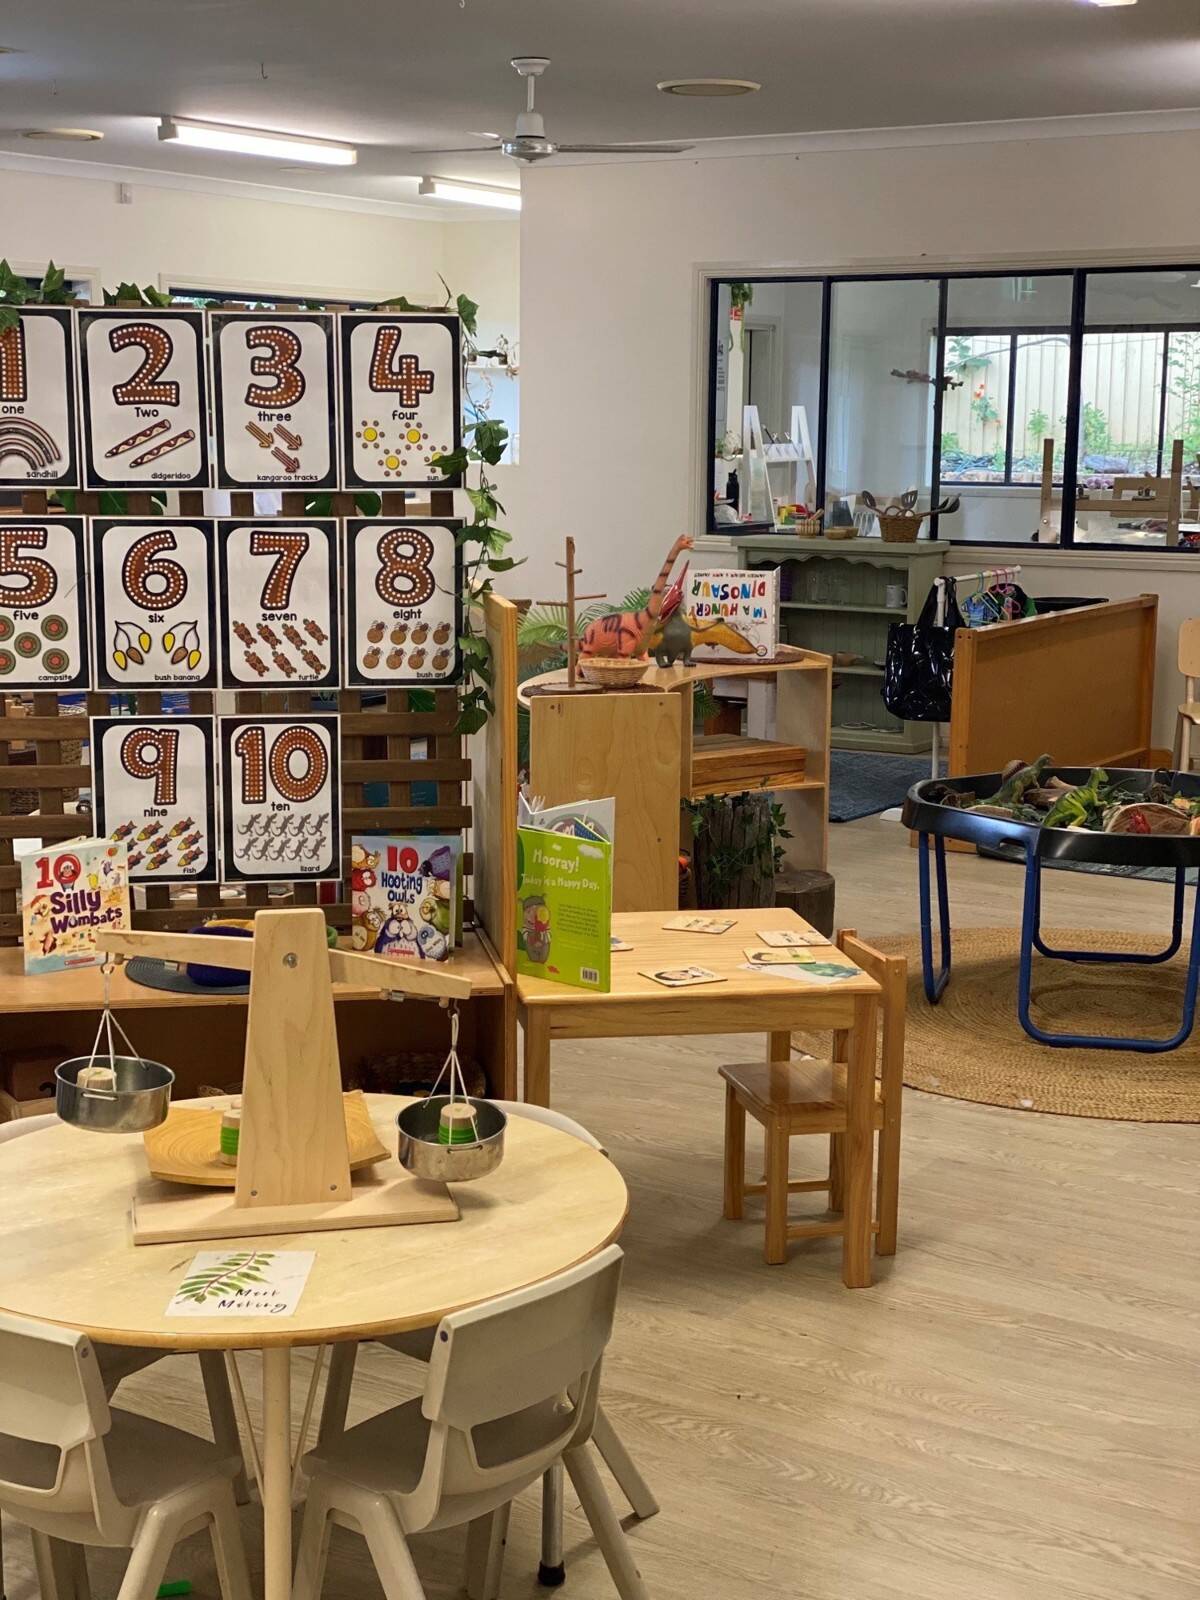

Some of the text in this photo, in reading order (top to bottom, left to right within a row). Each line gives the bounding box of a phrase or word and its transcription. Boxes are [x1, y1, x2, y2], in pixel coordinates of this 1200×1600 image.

[0, 317, 27, 402] 1
[109, 322, 180, 407] 2
[369, 325, 434, 408] 4
[244, 325, 306, 409] 3
[1, 404, 25, 415] one
[134, 407, 159, 418] Two
[257, 411, 292, 422] three
[392, 410, 418, 421] four
[26, 470, 59, 479] sandhill
[151, 472, 191, 481] didgeridoo
[257, 474, 318, 483] kangaroo tracks
[0, 527, 58, 609] 5
[122, 530, 188, 611] 6
[250, 530, 309, 610] 7
[375, 528, 435, 607] 8
[691, 579, 766, 600] DINOSAUR
[13, 610, 39, 621] five
[261, 612, 297, 622] seven
[393, 609, 422, 621] eight
[688, 603, 738, 617] HUNGRY
[743, 605, 750, 615] A
[148, 613, 165, 623] six
[38, 674, 73, 682] campsite
[154, 673, 200, 681] bush banana
[120, 727, 179, 806] 9
[235, 725, 328, 804] 10
[143, 807, 168, 817] nine
[271, 802, 290, 811] ten
[387, 846, 419, 874] 10
[533, 848, 579, 873] Hooray!
[35, 853, 81, 889] 10
[381, 871, 423, 895] Hooting
[557, 877, 580, 890] Happy
[50, 889, 101, 915] Silly
[50, 906, 123, 934] Wombats
